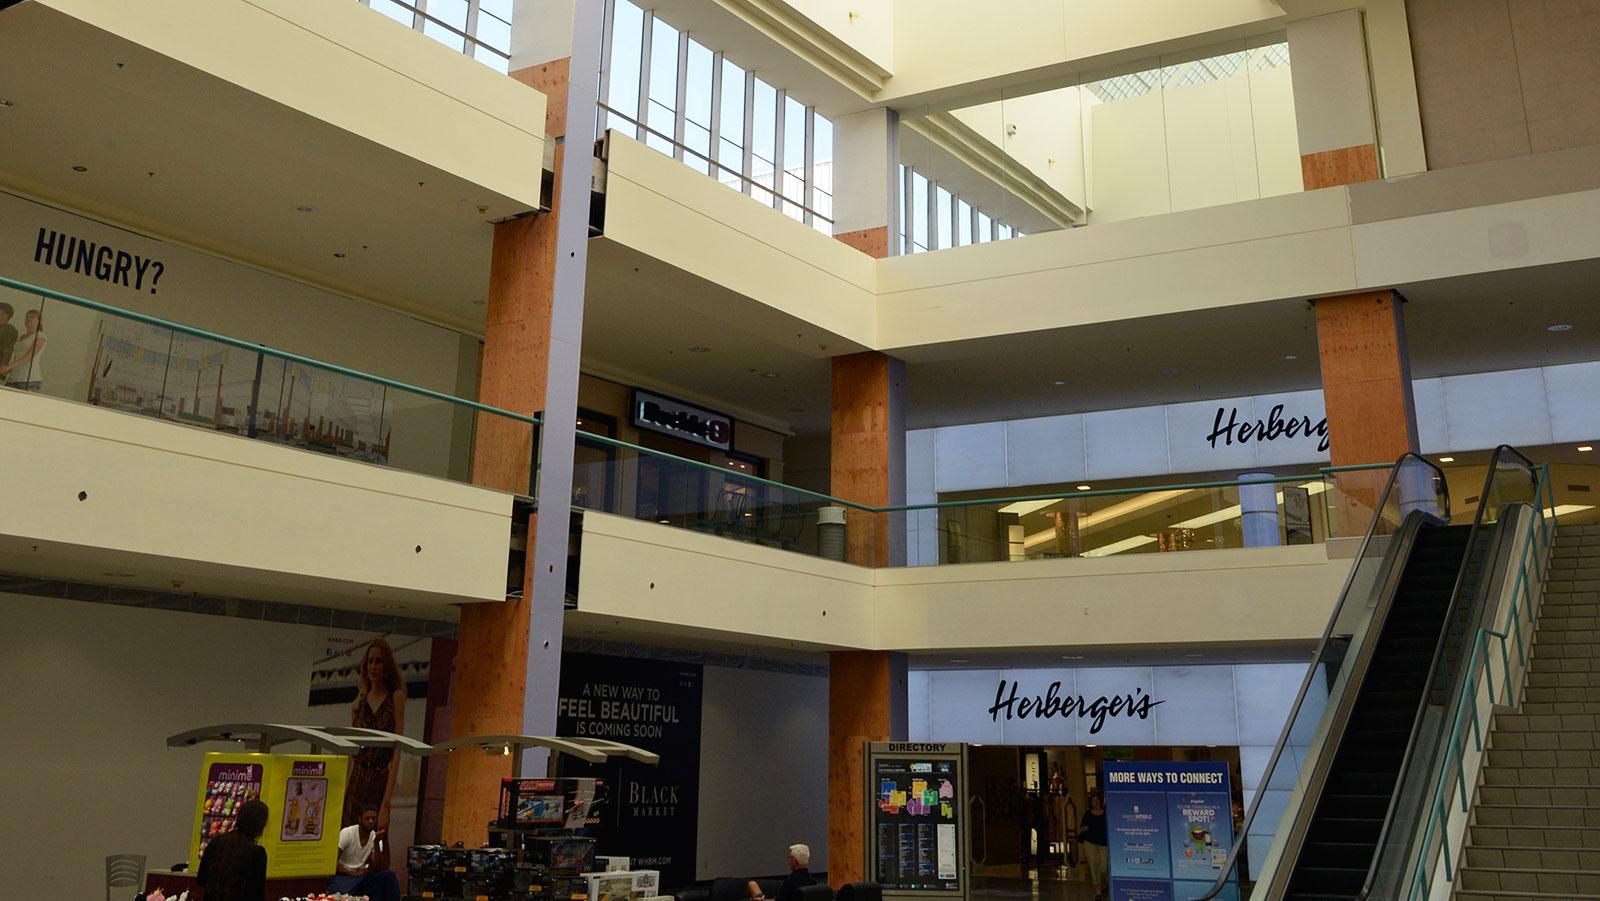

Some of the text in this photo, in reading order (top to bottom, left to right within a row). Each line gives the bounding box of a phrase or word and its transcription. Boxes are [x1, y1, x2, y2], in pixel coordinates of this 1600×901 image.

[34, 227, 165, 294] HUNGRY?
[583, 683, 660, 701] A NEW WAY TO
[558, 698, 680, 724] FEEL BEAUTIFUL
[988, 679, 1167, 734] Herberger's
[576, 721, 663, 739] IS COMING SOON
[888, 743, 946, 752] DIRECTORY
[1109, 772, 1223, 784] MORE WAYS TO CONNECT
[633, 806, 676, 817] MARKET
[1182, 809, 1215, 817] REWARD
